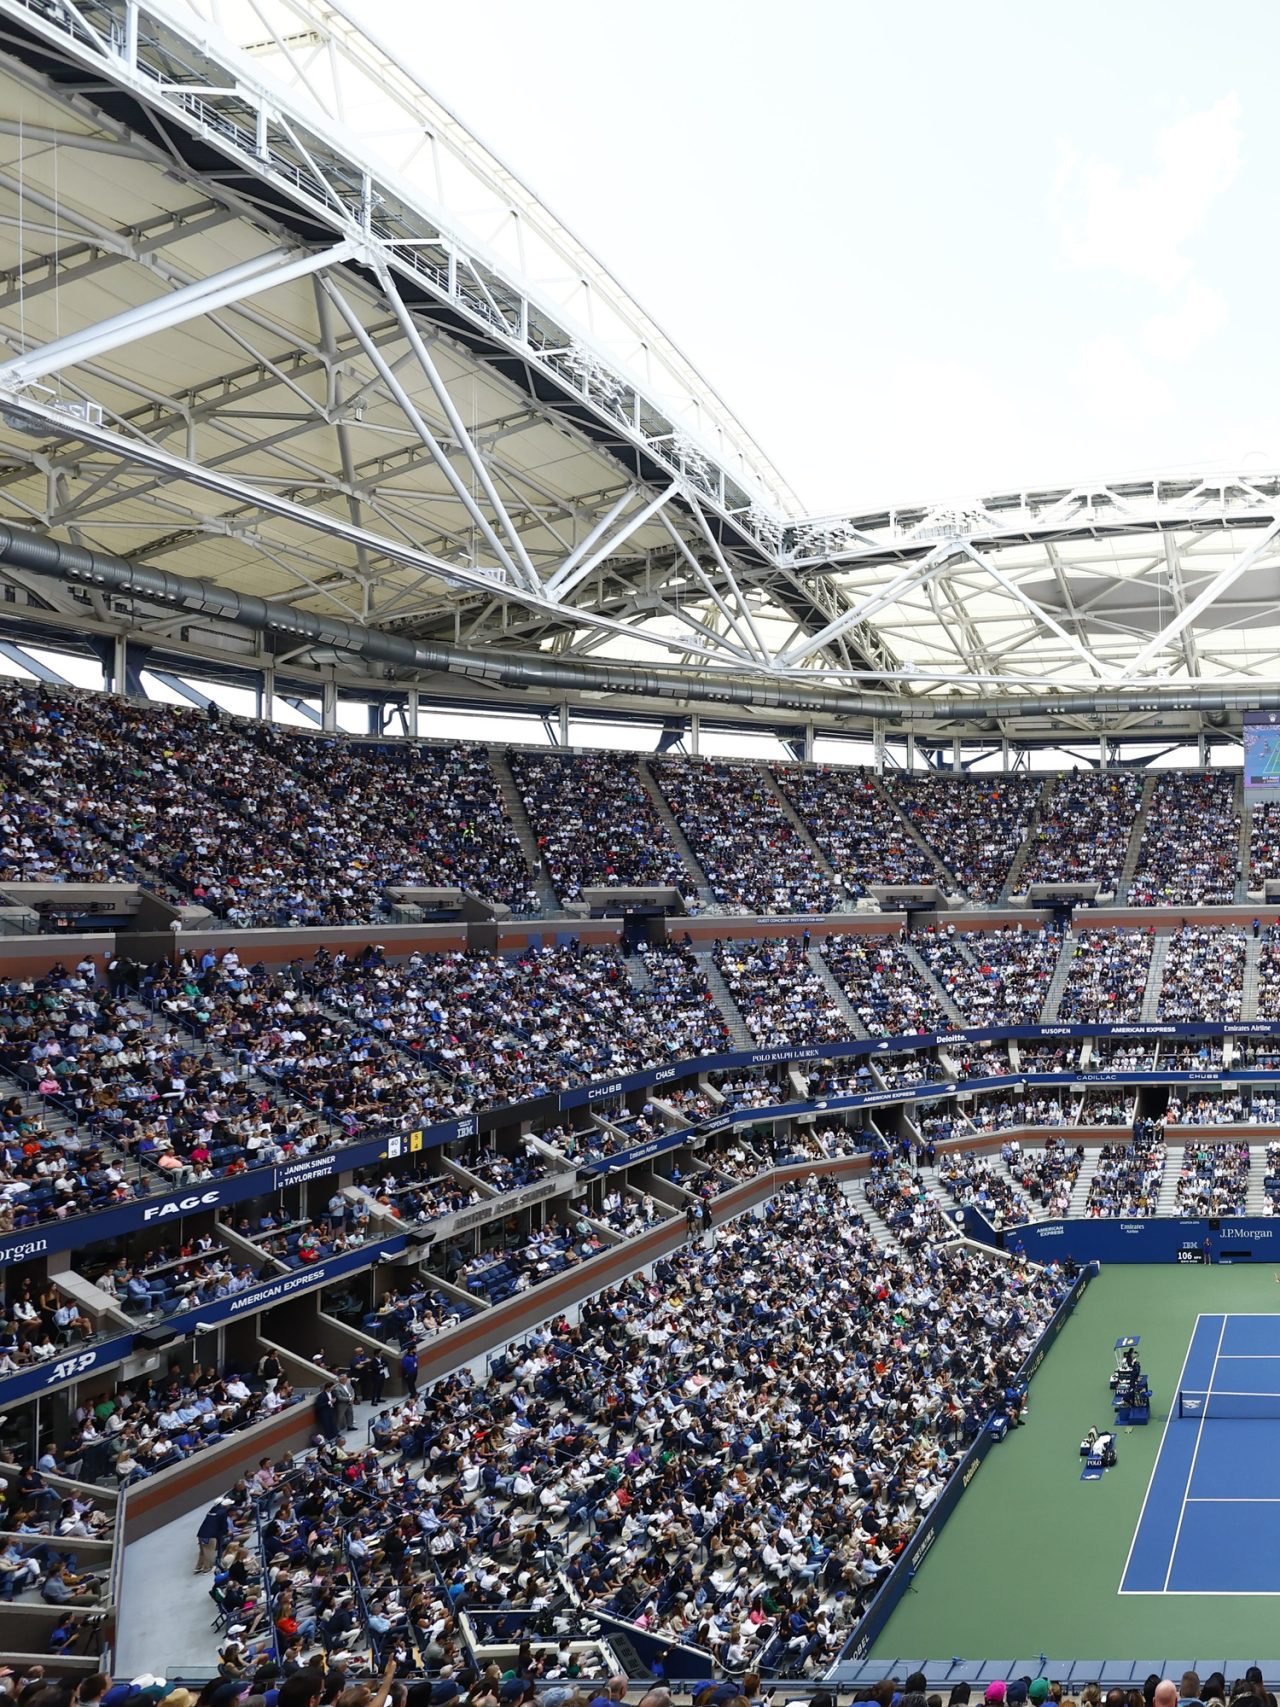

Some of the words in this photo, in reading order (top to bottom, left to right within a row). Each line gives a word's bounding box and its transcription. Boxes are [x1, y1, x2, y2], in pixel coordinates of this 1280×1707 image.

[752, 1054, 770, 1062] POLO
[771, 1052, 793, 1060] RALPH
[794, 1049, 819, 1058] LAUREN
[655, 1068, 676, 1081] CHASE
[588, 1083, 622, 1099] CHUBB
[863, 1093, 891, 1102] AMERICAN
[891, 1091, 916, 1099] EXPRESS
[414, 1133, 419, 1141] 5
[457, 1125, 473, 1138] IBM
[284, 1161, 310, 1175] JANNIK
[311, 1155, 336, 1168] SINNER
[284, 1172, 312, 1187] TAYLOR
[313, 1166, 332, 1178] FRITZ
[144, 1190, 220, 1221] FAGE
[1036, 1225, 1064, 1234] AMERICAN
[1220, 1229, 1273, 1239] J.P.Morgan
[1182, 1241, 1198, 1249] IBM
[1178, 1251, 1192, 1260] 106
[230, 1285, 281, 1312] AMERICAN
[284, 1269, 325, 1292] EXPRESS
[47, 1351, 97, 1383] ATP
